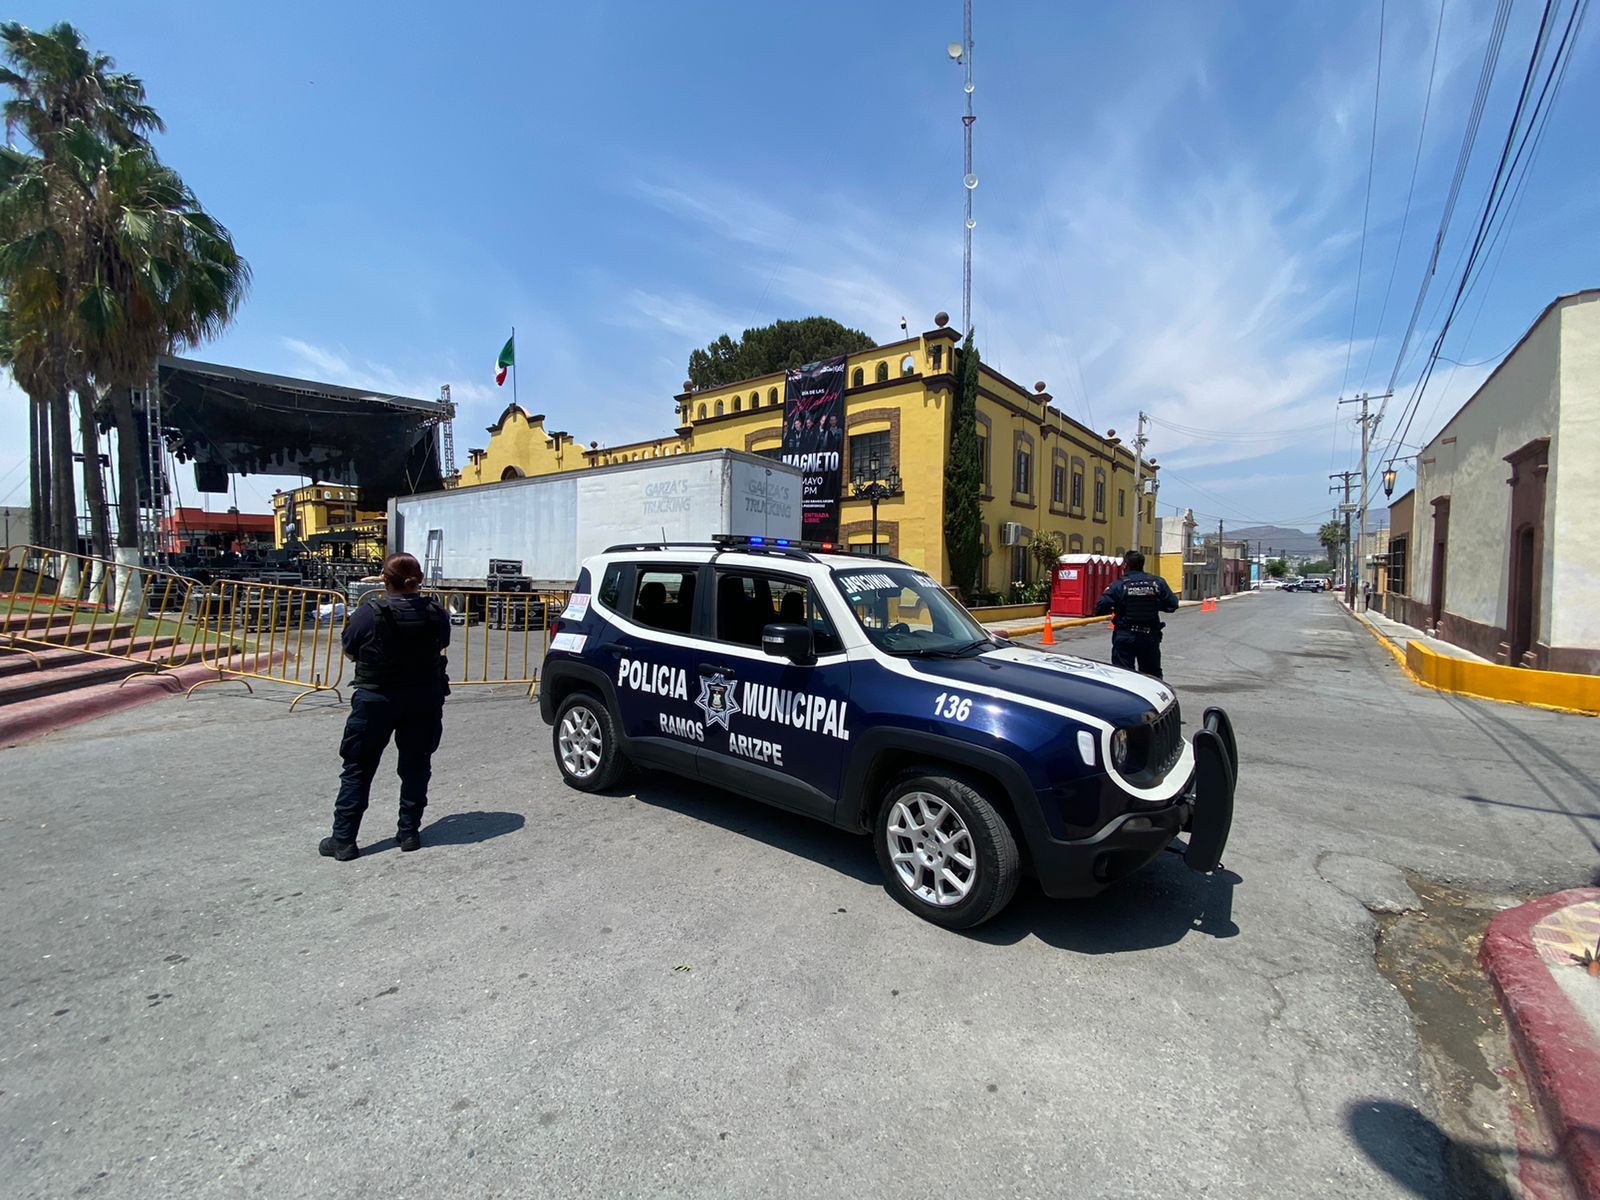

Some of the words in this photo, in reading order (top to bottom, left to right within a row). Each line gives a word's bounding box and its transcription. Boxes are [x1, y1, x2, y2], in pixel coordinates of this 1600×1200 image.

[804, 486, 817, 495] PM
[642, 497, 691, 515] TRUCKING
[744, 497, 792, 518] TRUCKING
[617, 658, 688, 701] POLICIA
[742, 681, 850, 741] MUNICIPAL
[934, 692, 973, 722] 136
[659, 712, 705, 742] RAMOS
[728, 732, 784, 767] ARIZPE
